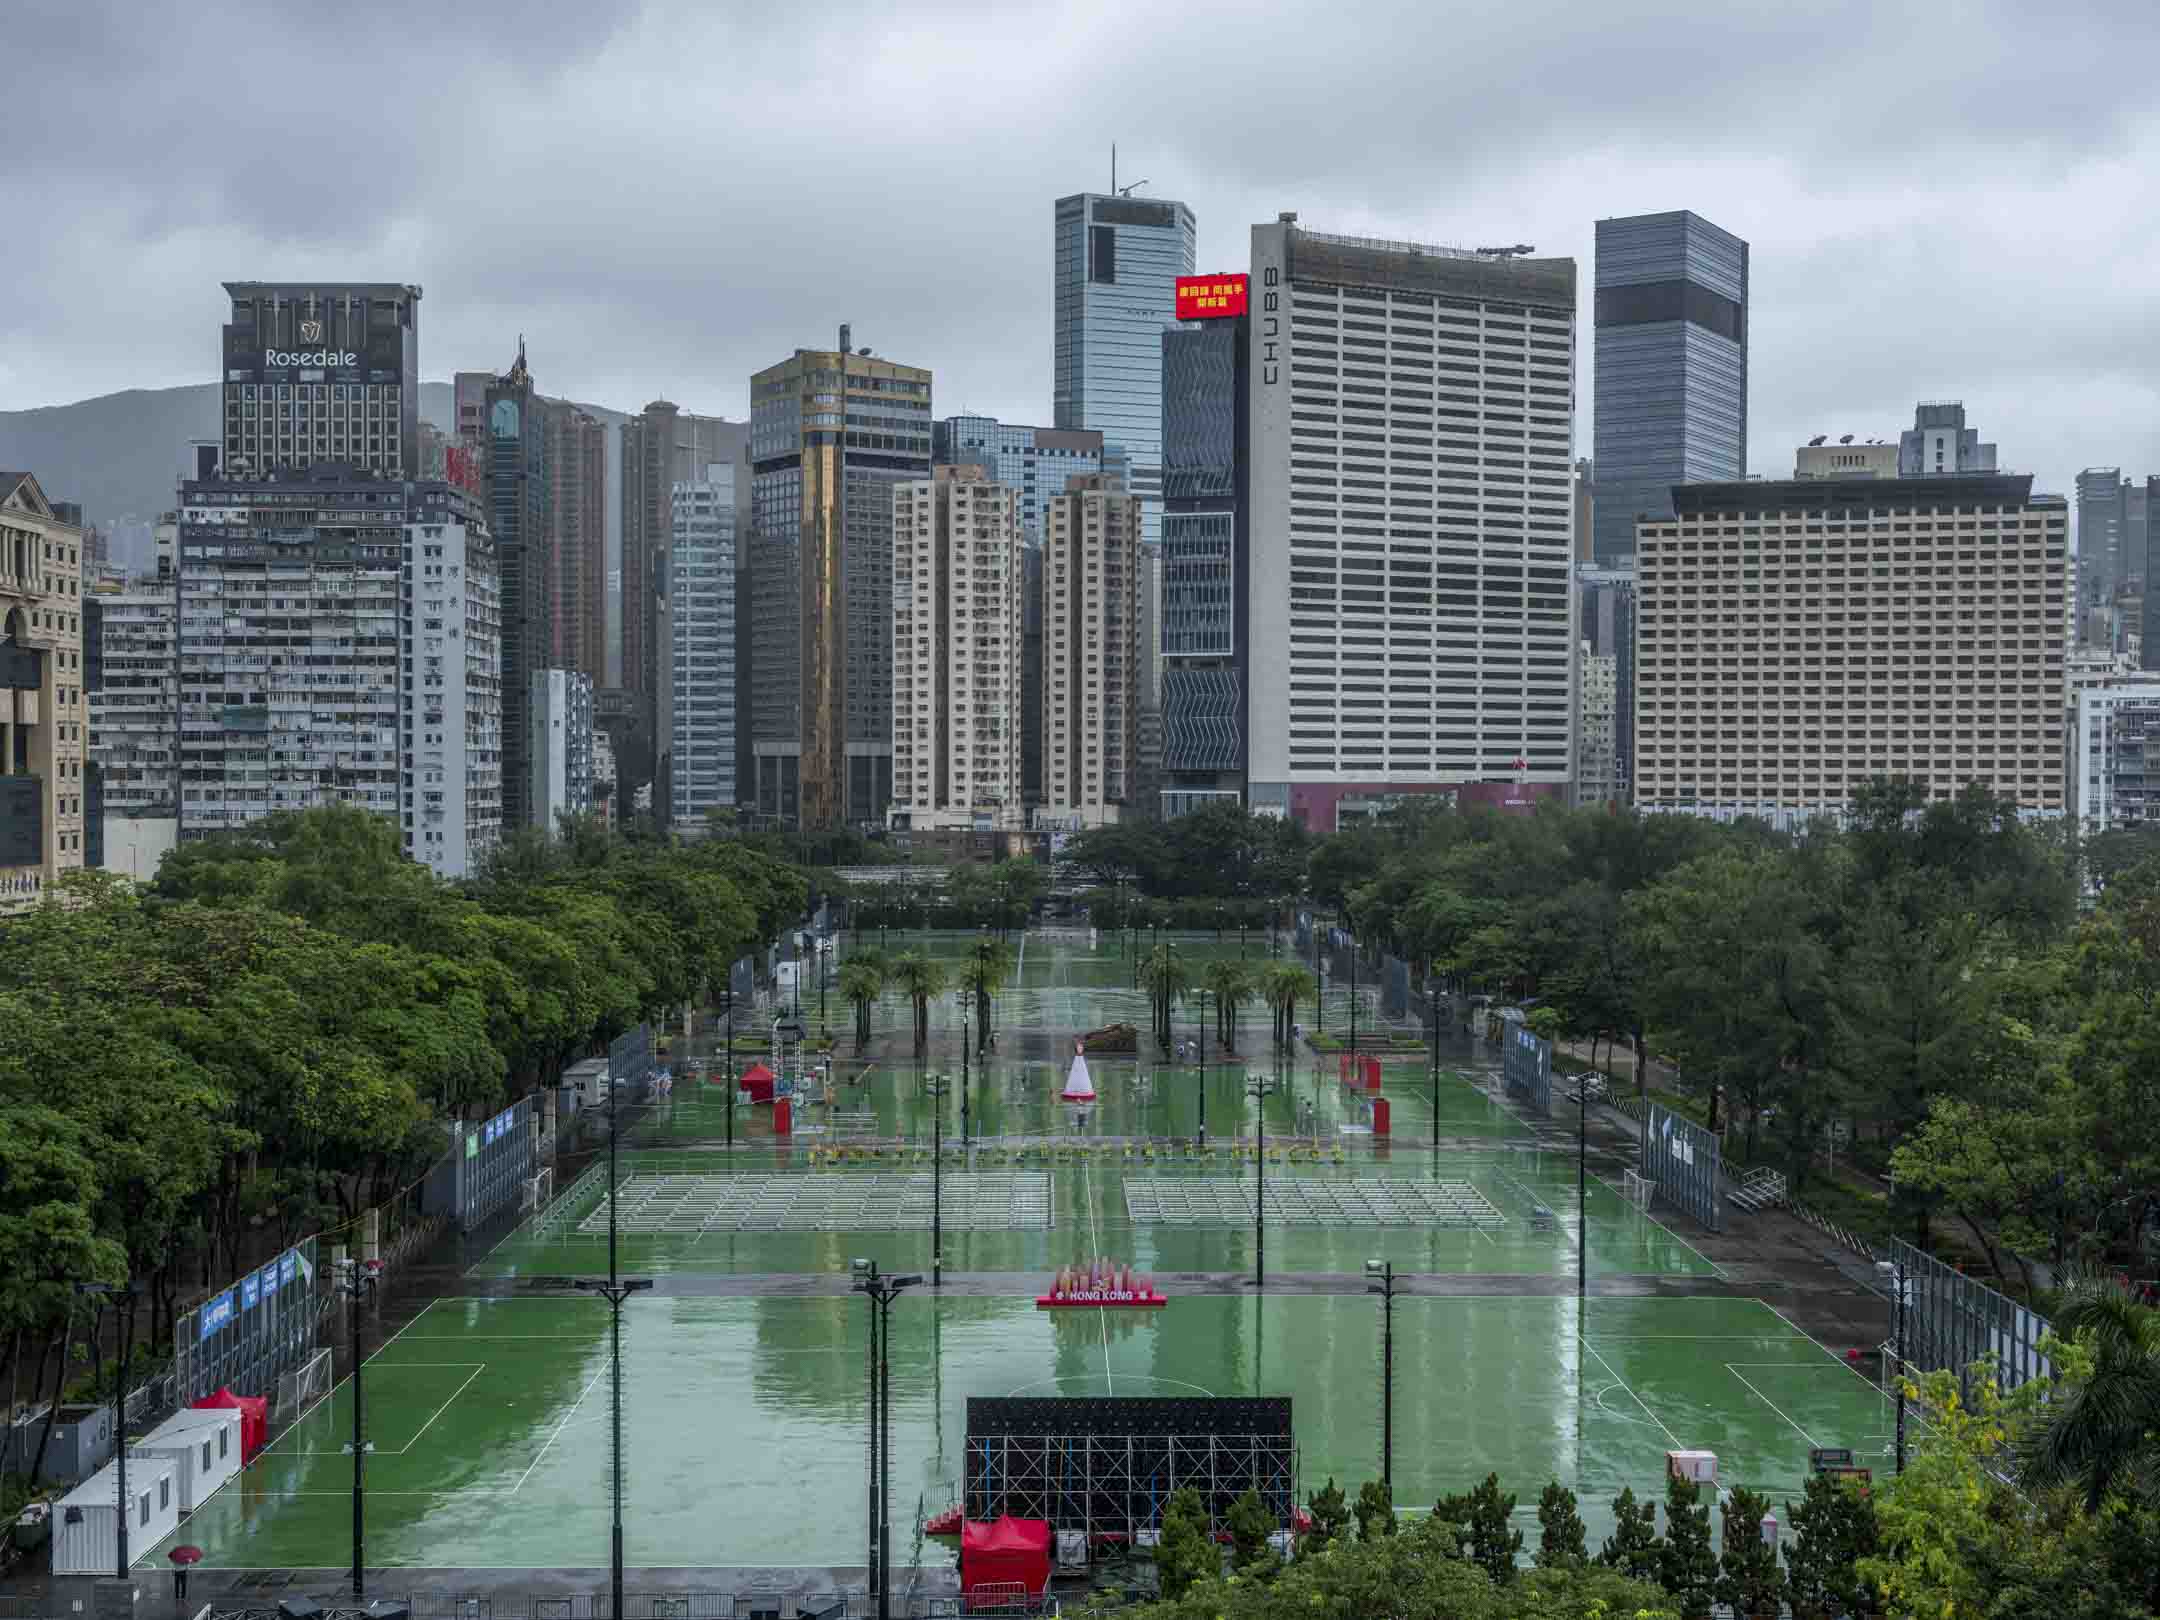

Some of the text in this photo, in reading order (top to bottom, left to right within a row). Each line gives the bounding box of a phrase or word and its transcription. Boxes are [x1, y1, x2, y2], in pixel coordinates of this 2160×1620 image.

[1264, 266, 1279, 385] CHUBB
[265, 347, 358, 367] Rosedale
[1070, 1290, 1134, 1301] HONG KONG
